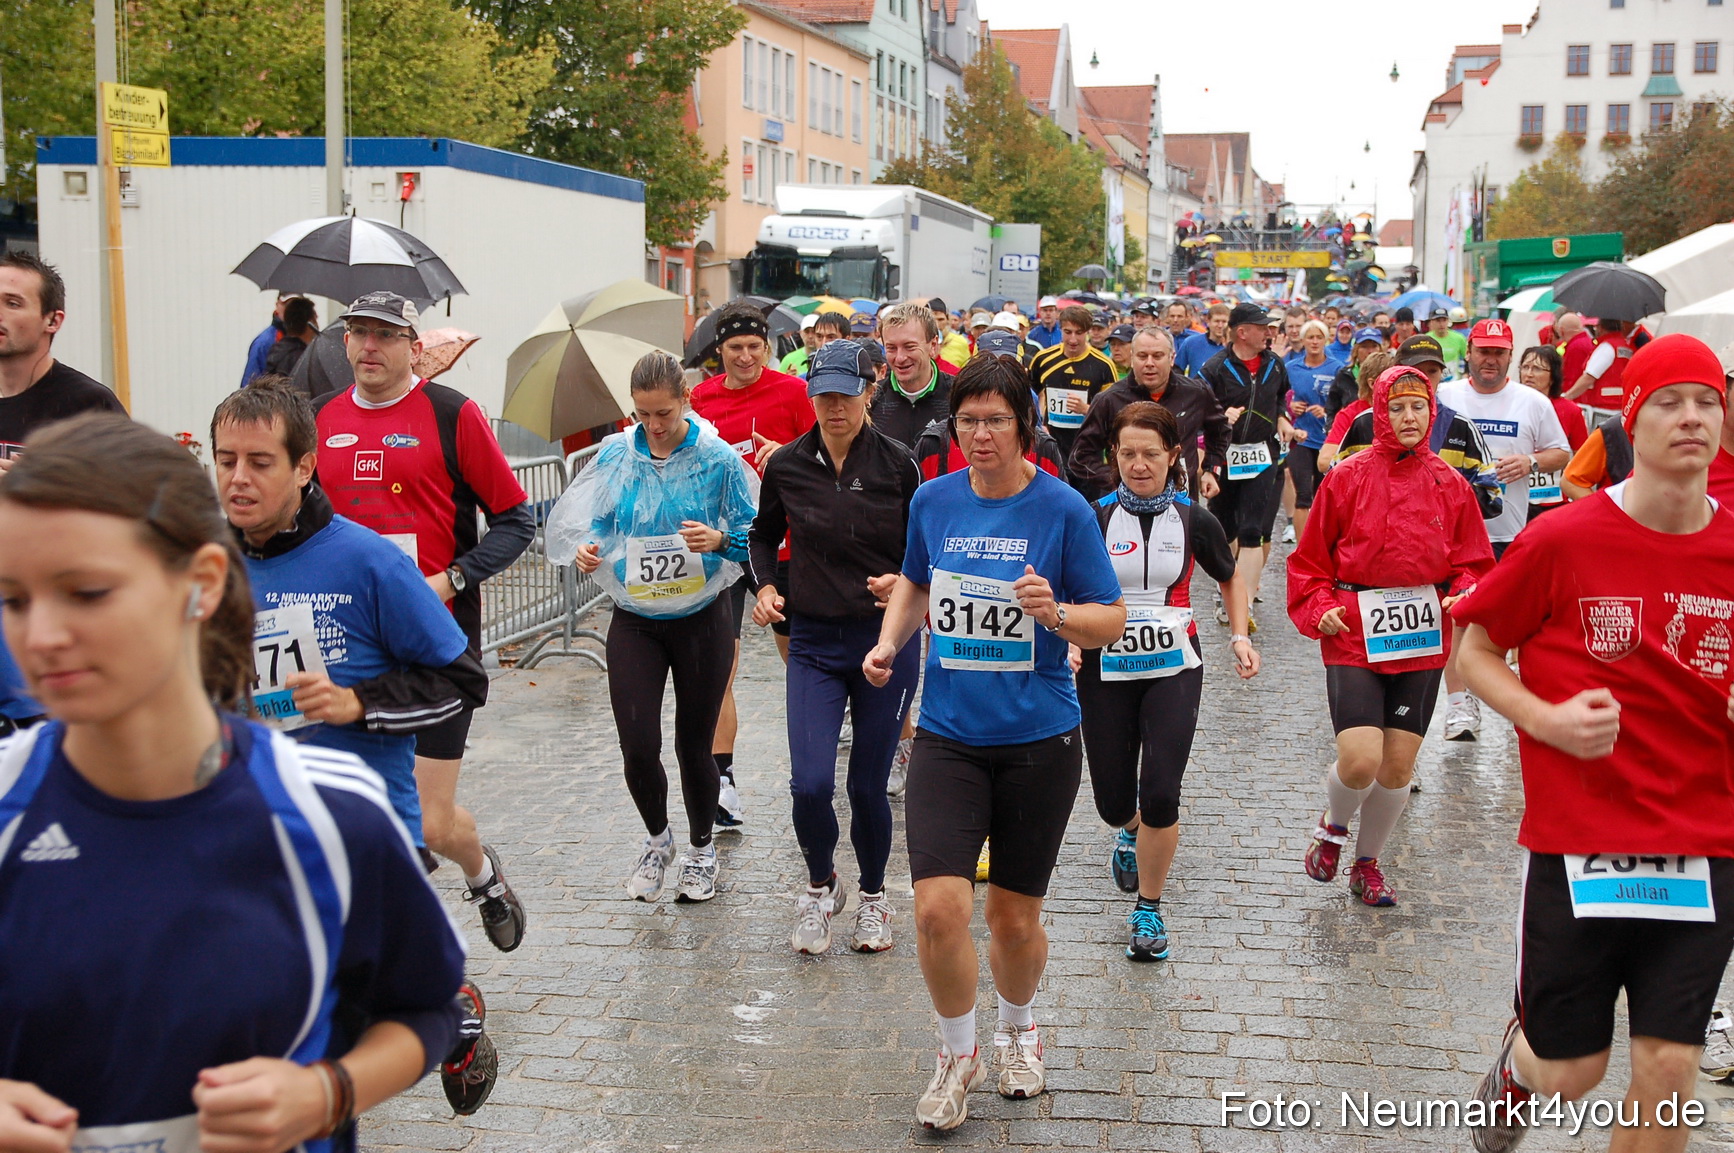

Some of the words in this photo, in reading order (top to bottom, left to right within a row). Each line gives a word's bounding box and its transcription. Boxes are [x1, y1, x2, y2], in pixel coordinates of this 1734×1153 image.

[114, 88, 149, 106] Kinder-
[788, 226, 849, 241] BOCK
[1251, 254, 1291, 266] START
[1231, 450, 1267, 465] 2846
[357, 459, 379, 472] GfK
[644, 540, 674, 549] BOCK
[1111, 541, 1131, 552] tkn
[966, 551, 981, 559] Wir
[982, 552, 1000, 560] sind
[1001, 553, 1025, 563] Sport.
[640, 554, 688, 583] 522
[651, 585, 683, 597] Vivien
[960, 581, 1001, 595] BOCK
[1383, 590, 1413, 600] BOCK
[265, 592, 280, 603] 12.
[281, 592, 353, 604] NEUMARKTER
[1663, 592, 1679, 604] 11.
[1680, 593, 1734, 610] NEUMARKT
[937, 597, 1024, 639] 3142
[1370, 602, 1435, 634] 2504
[1589, 606, 1633, 617] IMMER
[1677, 602, 1732, 620] STADTLAUF
[1588, 616, 1635, 628] WIEDER
[1592, 627, 1632, 642] NEU
[1383, 636, 1427, 650] Manuela
[1591, 640, 1631, 652] MARKT
[953, 642, 1004, 660] Birgitta
[1118, 656, 1166, 671] Manuela
[1615, 882, 1669, 900] Julian
